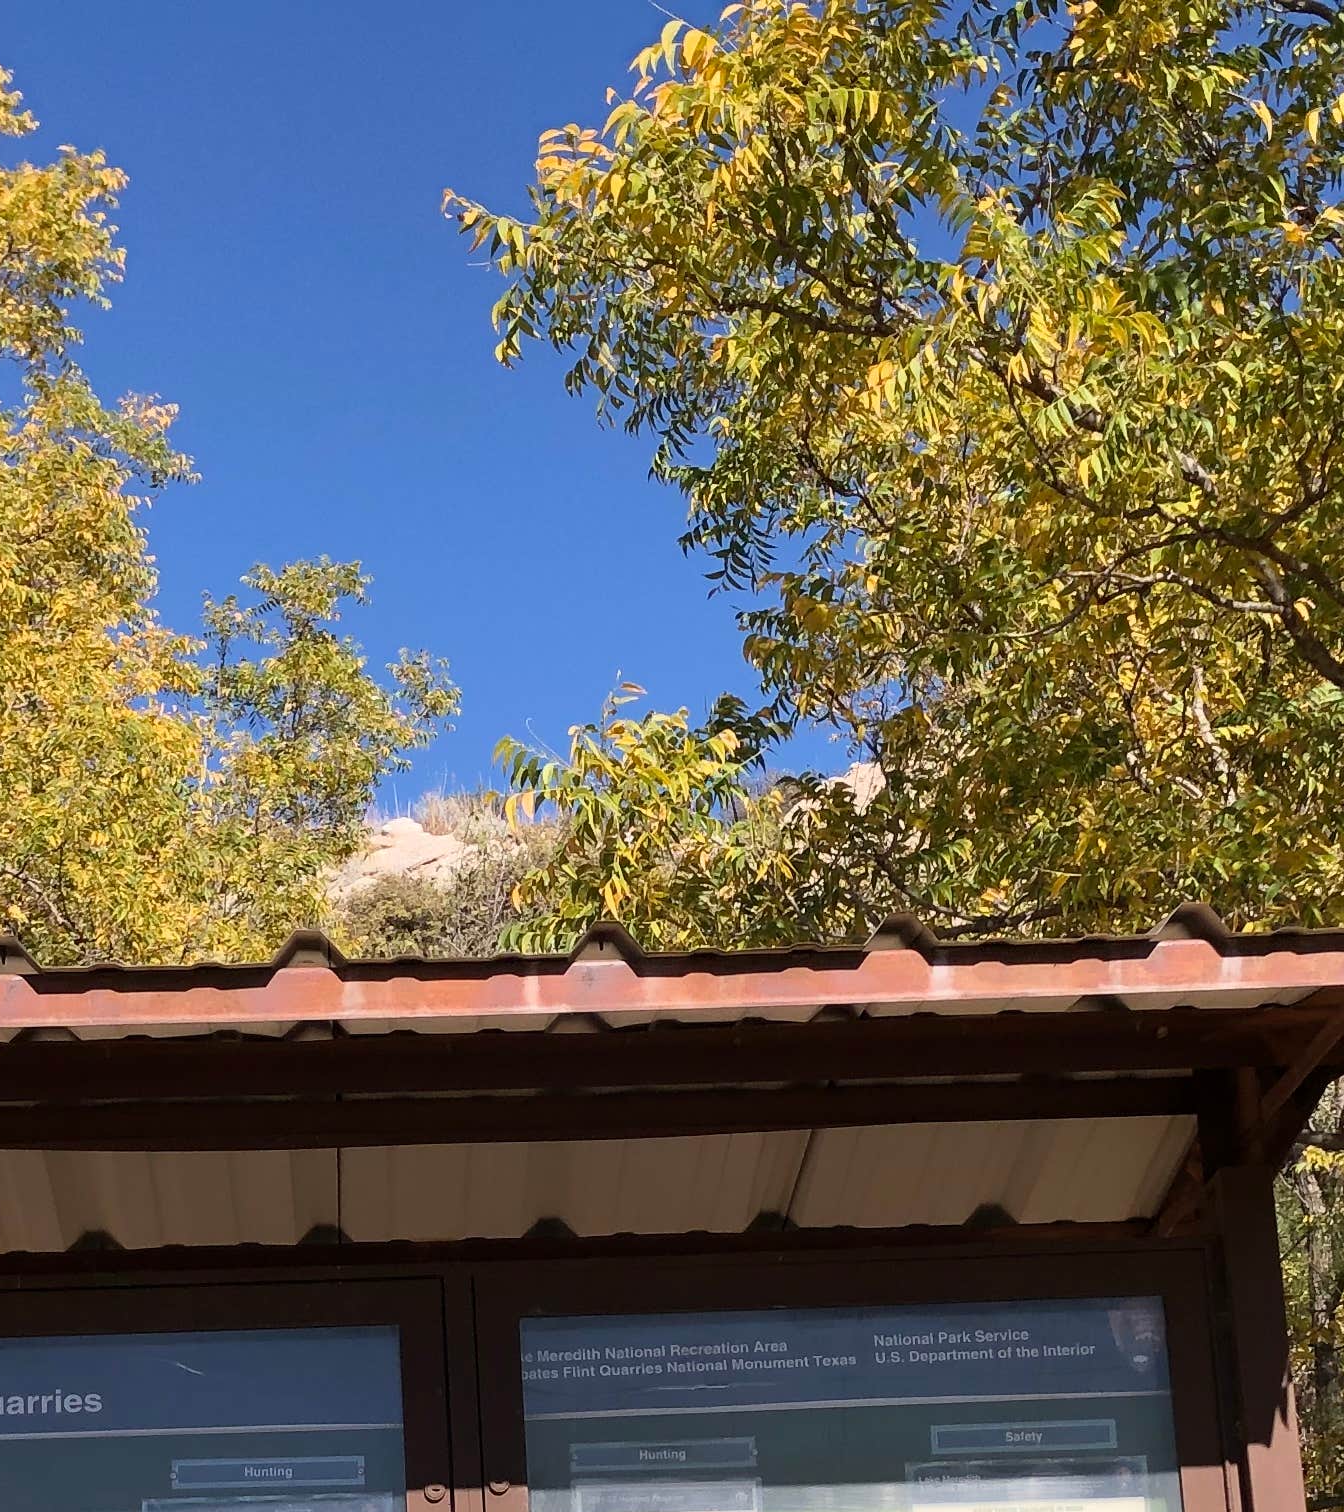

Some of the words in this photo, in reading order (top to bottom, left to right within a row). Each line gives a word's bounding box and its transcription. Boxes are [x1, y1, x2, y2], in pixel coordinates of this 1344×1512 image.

[873, 1333, 934, 1347] National
[938, 1332, 971, 1344] Park
[975, 1329, 1029, 1342] Service
[537, 1348, 600, 1362] Meredith
[605, 1345, 665, 1360] National
[671, 1342, 749, 1357] Recreation
[754, 1340, 787, 1353] Area
[875, 1351, 905, 1364] U.S.
[909, 1348, 994, 1364] Department
[998, 1347, 1012, 1358] of
[1016, 1346, 1039, 1358] the
[1043, 1343, 1096, 1357] Interior
[563, 1365, 596, 1378] Flint
[599, 1363, 662, 1377] Quarries
[667, 1360, 727, 1374] National
[731, 1356, 809, 1371] Monument
[812, 1355, 857, 1368] Texas
[1006, 1431, 1043, 1444] Safety
[639, 1449, 686, 1462] Hunting
[244, 1466, 293, 1480] Hunting
